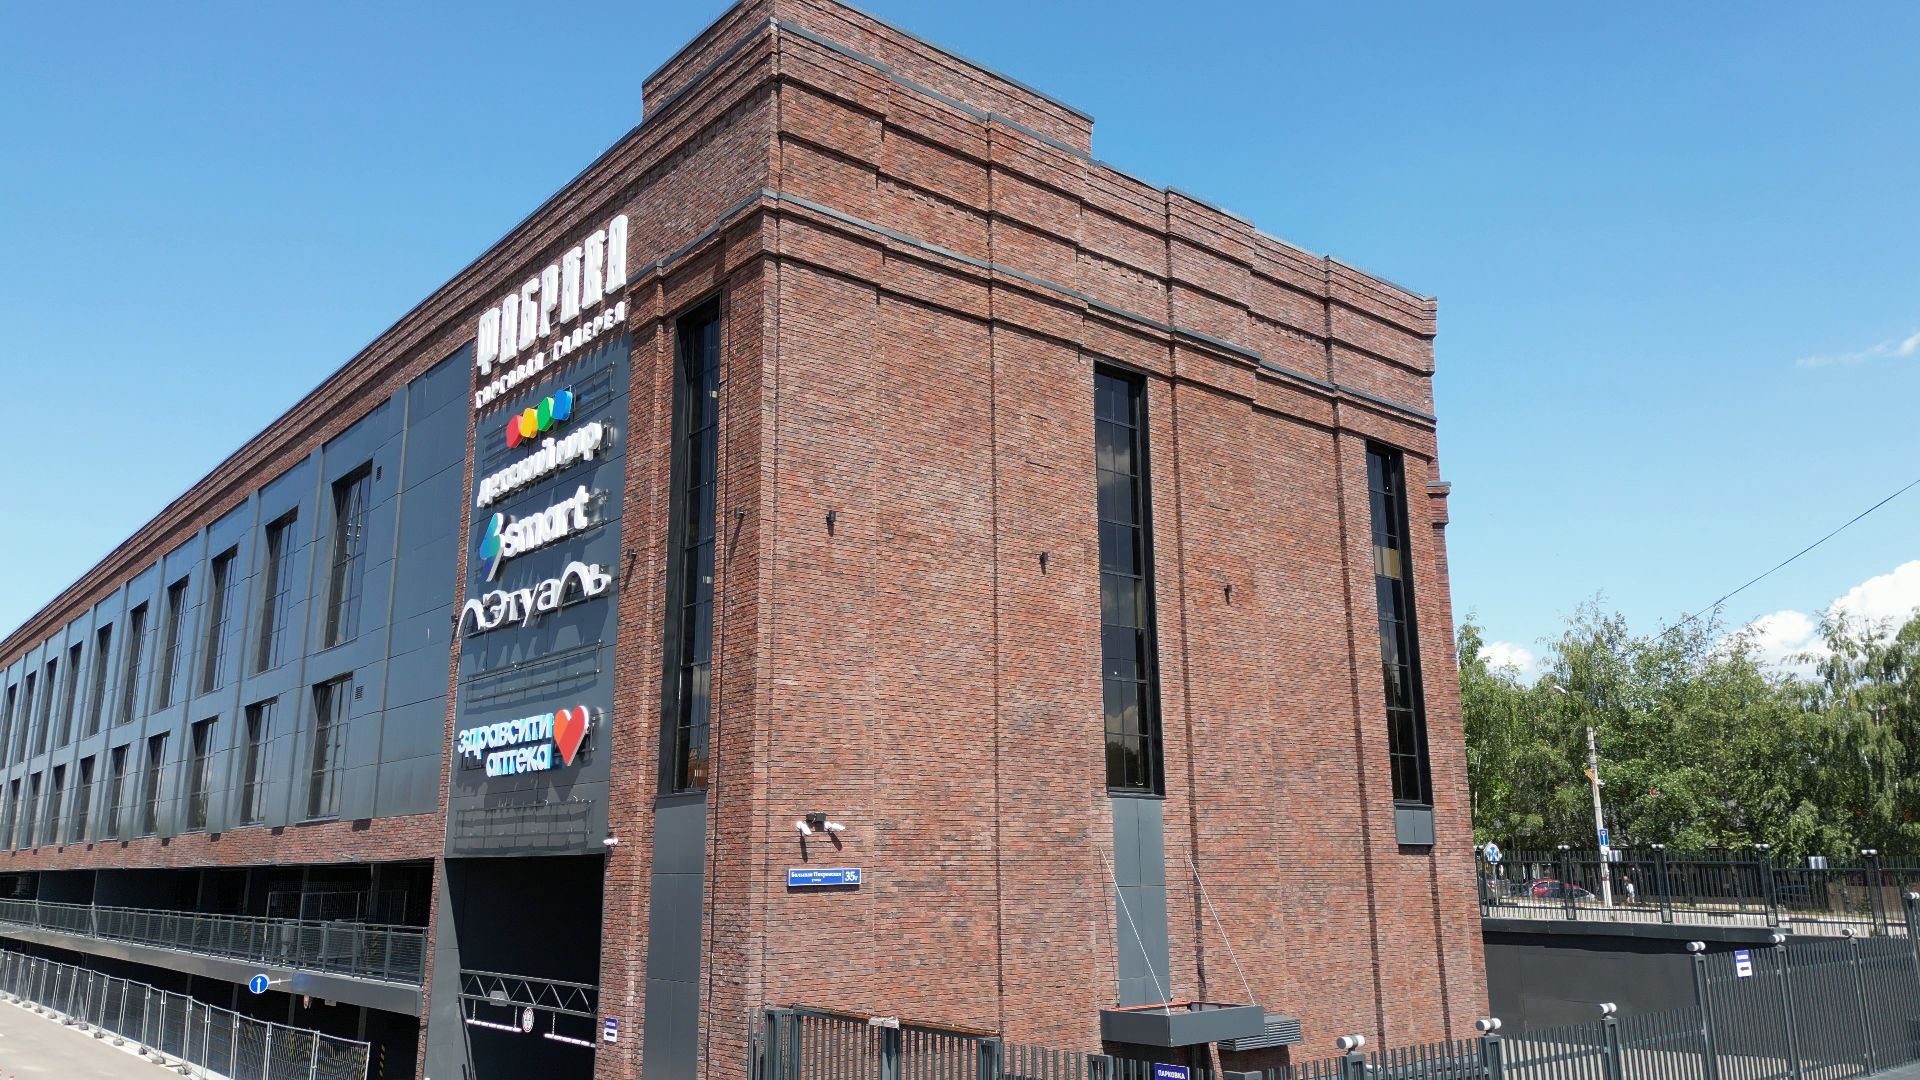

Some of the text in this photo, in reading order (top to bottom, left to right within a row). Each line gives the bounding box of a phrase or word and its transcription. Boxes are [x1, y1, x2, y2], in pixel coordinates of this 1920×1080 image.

[477, 214, 628, 375] ФАБРИКА
[475, 301, 625, 408] ТОРГОВАЯ ГАЛЕРЕЯ
[503, 485, 588, 557] smart
[458, 713, 554, 759] здравсити
[486, 743, 552, 777] аптека
[1157, 1069, 1186, 1080] ПАРКОВКА
